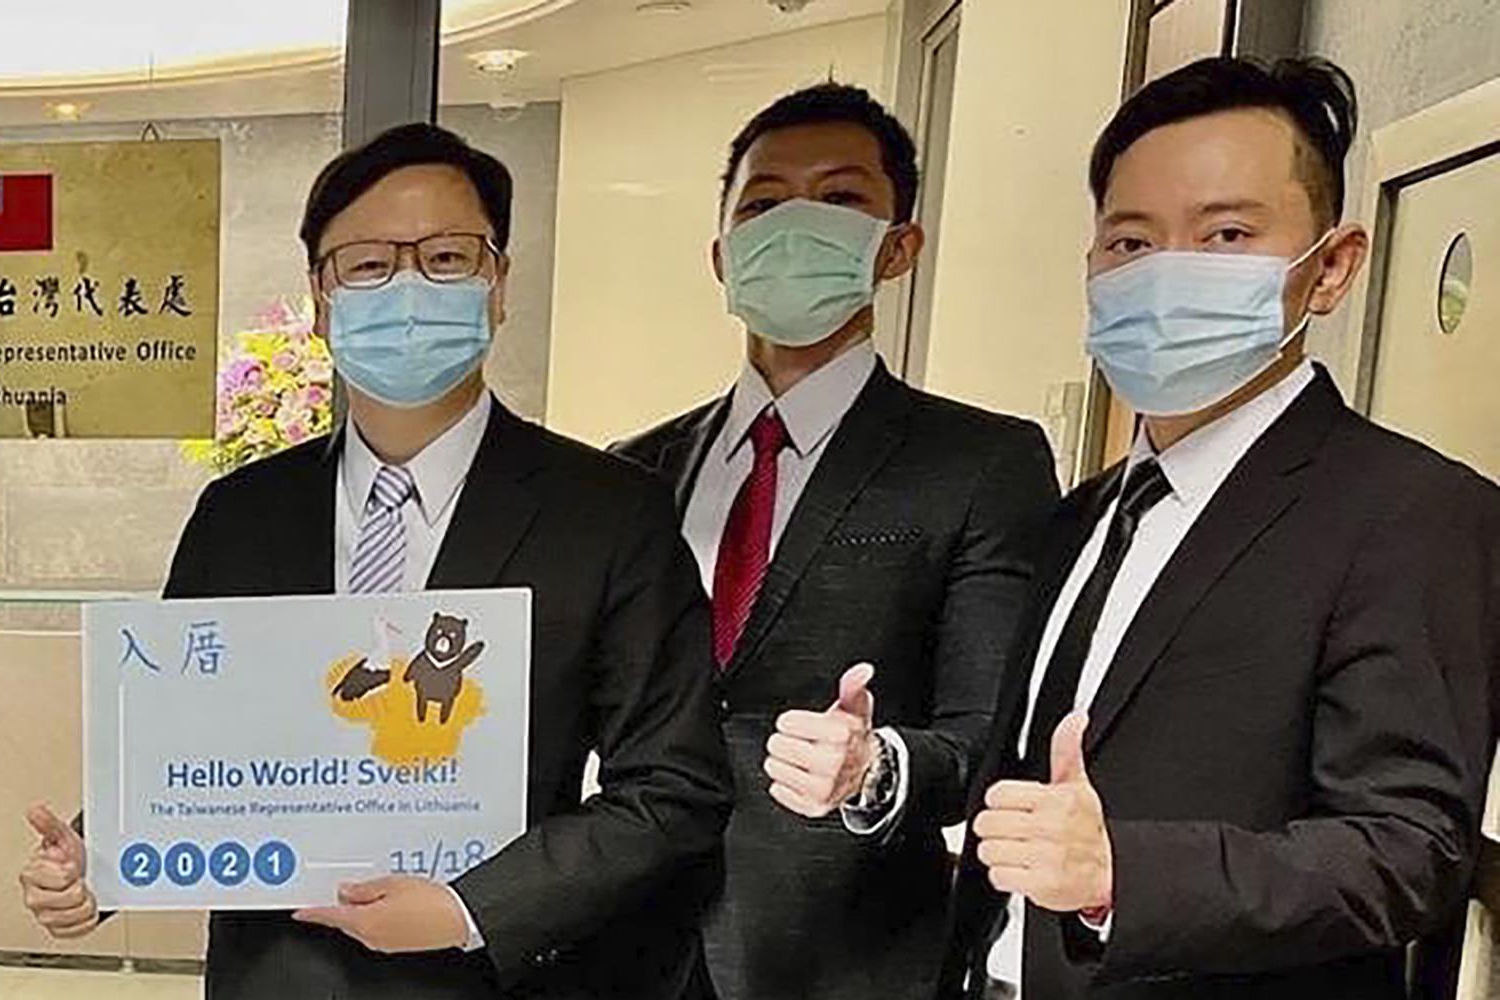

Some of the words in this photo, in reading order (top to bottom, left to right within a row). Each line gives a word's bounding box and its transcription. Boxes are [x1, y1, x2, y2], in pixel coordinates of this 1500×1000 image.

[136, 340, 197, 362] Office
[118, 620, 227, 676] 入厝
[167, 761, 244, 788] Hello
[250, 758, 349, 786] World!
[358, 758, 458, 786] Sveiki!
[151, 802, 175, 816] The
[177, 802, 247, 816] Taiwanese
[250, 799, 352, 818] Representative
[355, 798, 396, 814] Office
[399, 801, 412, 813] in
[415, 798, 481, 813] Lithuania
[390, 839, 484, 878] 11/18
